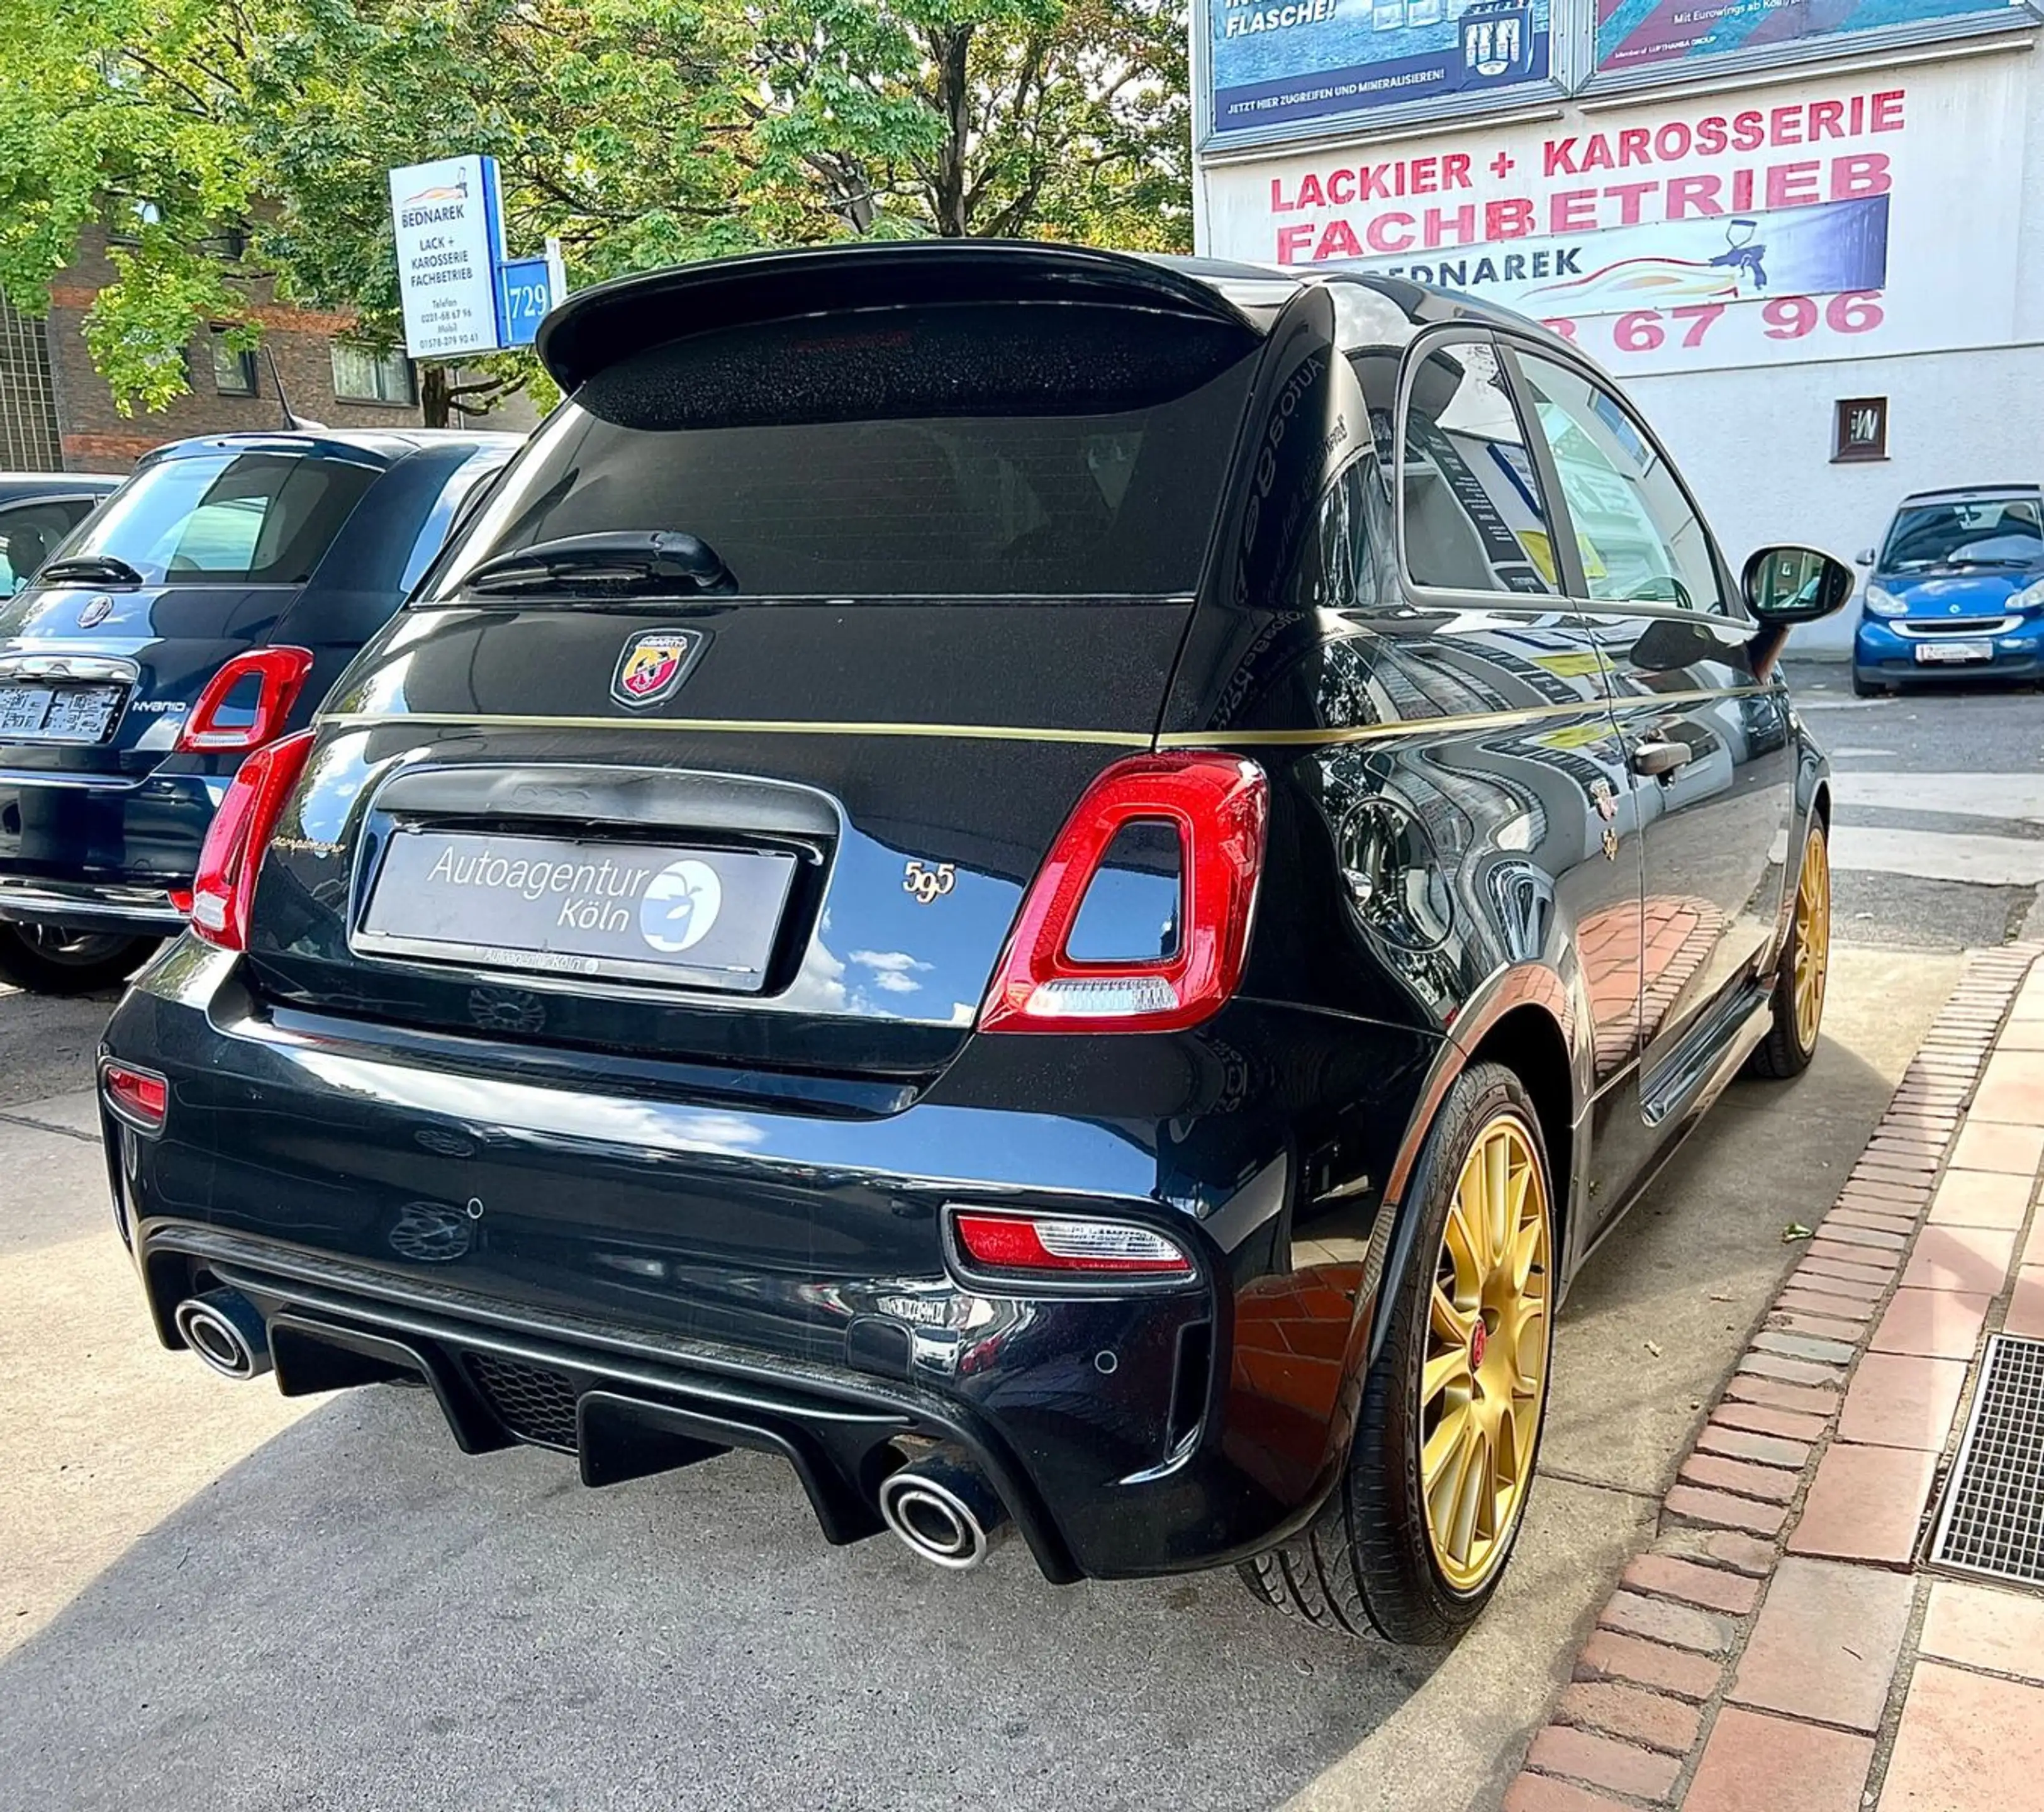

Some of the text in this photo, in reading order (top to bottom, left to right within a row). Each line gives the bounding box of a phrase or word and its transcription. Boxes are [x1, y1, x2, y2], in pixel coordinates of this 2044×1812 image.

[1227, 0, 1335, 38] FLASCHE!
[1673, 13, 1691, 24] Mit
[1693, 5, 1745, 21] Eurowings
[1747, 2, 1761, 12] ab
[1227, 69, 1444, 115] JETZT HIER ZUGREIFEN UND MINERALISIEREN!
[1271, 89, 1906, 213] LACKIER + KAROSSERIE
[402, 204, 464, 228] BEDNAREK
[1277, 152, 1892, 266] FACHBETRIEB
[411, 250, 468, 269] KAROSSERIE
[420, 237, 445, 251] LACK
[411, 267, 472, 287] FACHBETRIEB
[432, 298, 457, 309] Telefon
[510, 284, 547, 319] 729
[1613, 303, 1726, 352] 67
[1762, 289, 1884, 340] 96
[132, 701, 187, 712] HYBRID
[427, 846, 651, 900] Autoagentur
[902, 861, 955, 903] 595
[557, 898, 630, 932] Köln
